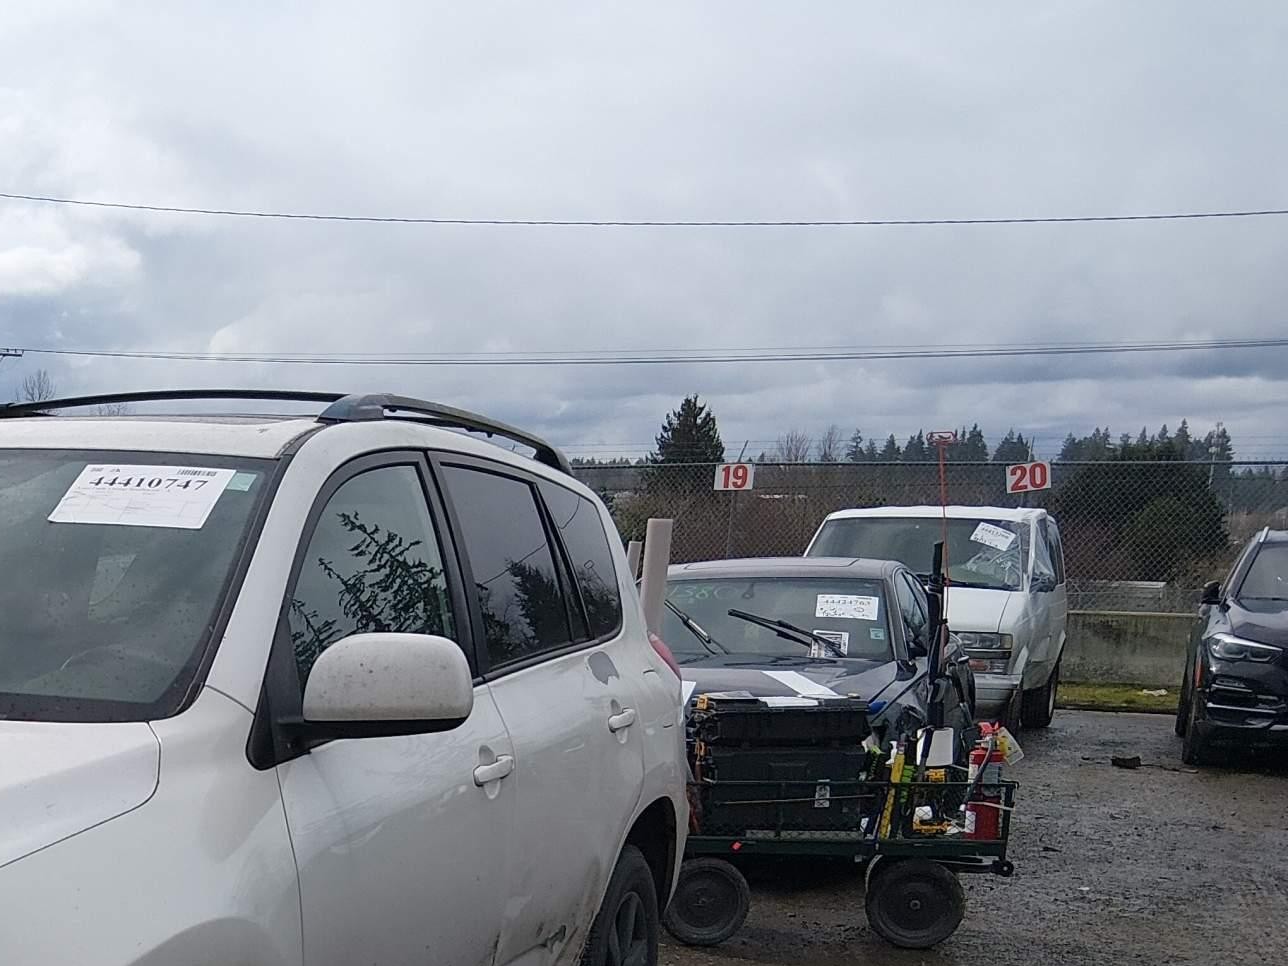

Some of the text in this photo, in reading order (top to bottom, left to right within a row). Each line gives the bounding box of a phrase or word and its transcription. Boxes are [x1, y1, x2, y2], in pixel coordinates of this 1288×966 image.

[89, 476, 208, 490] 44410747
[721, 465, 749, 489] 19
[1010, 462, 1048, 491] 20
